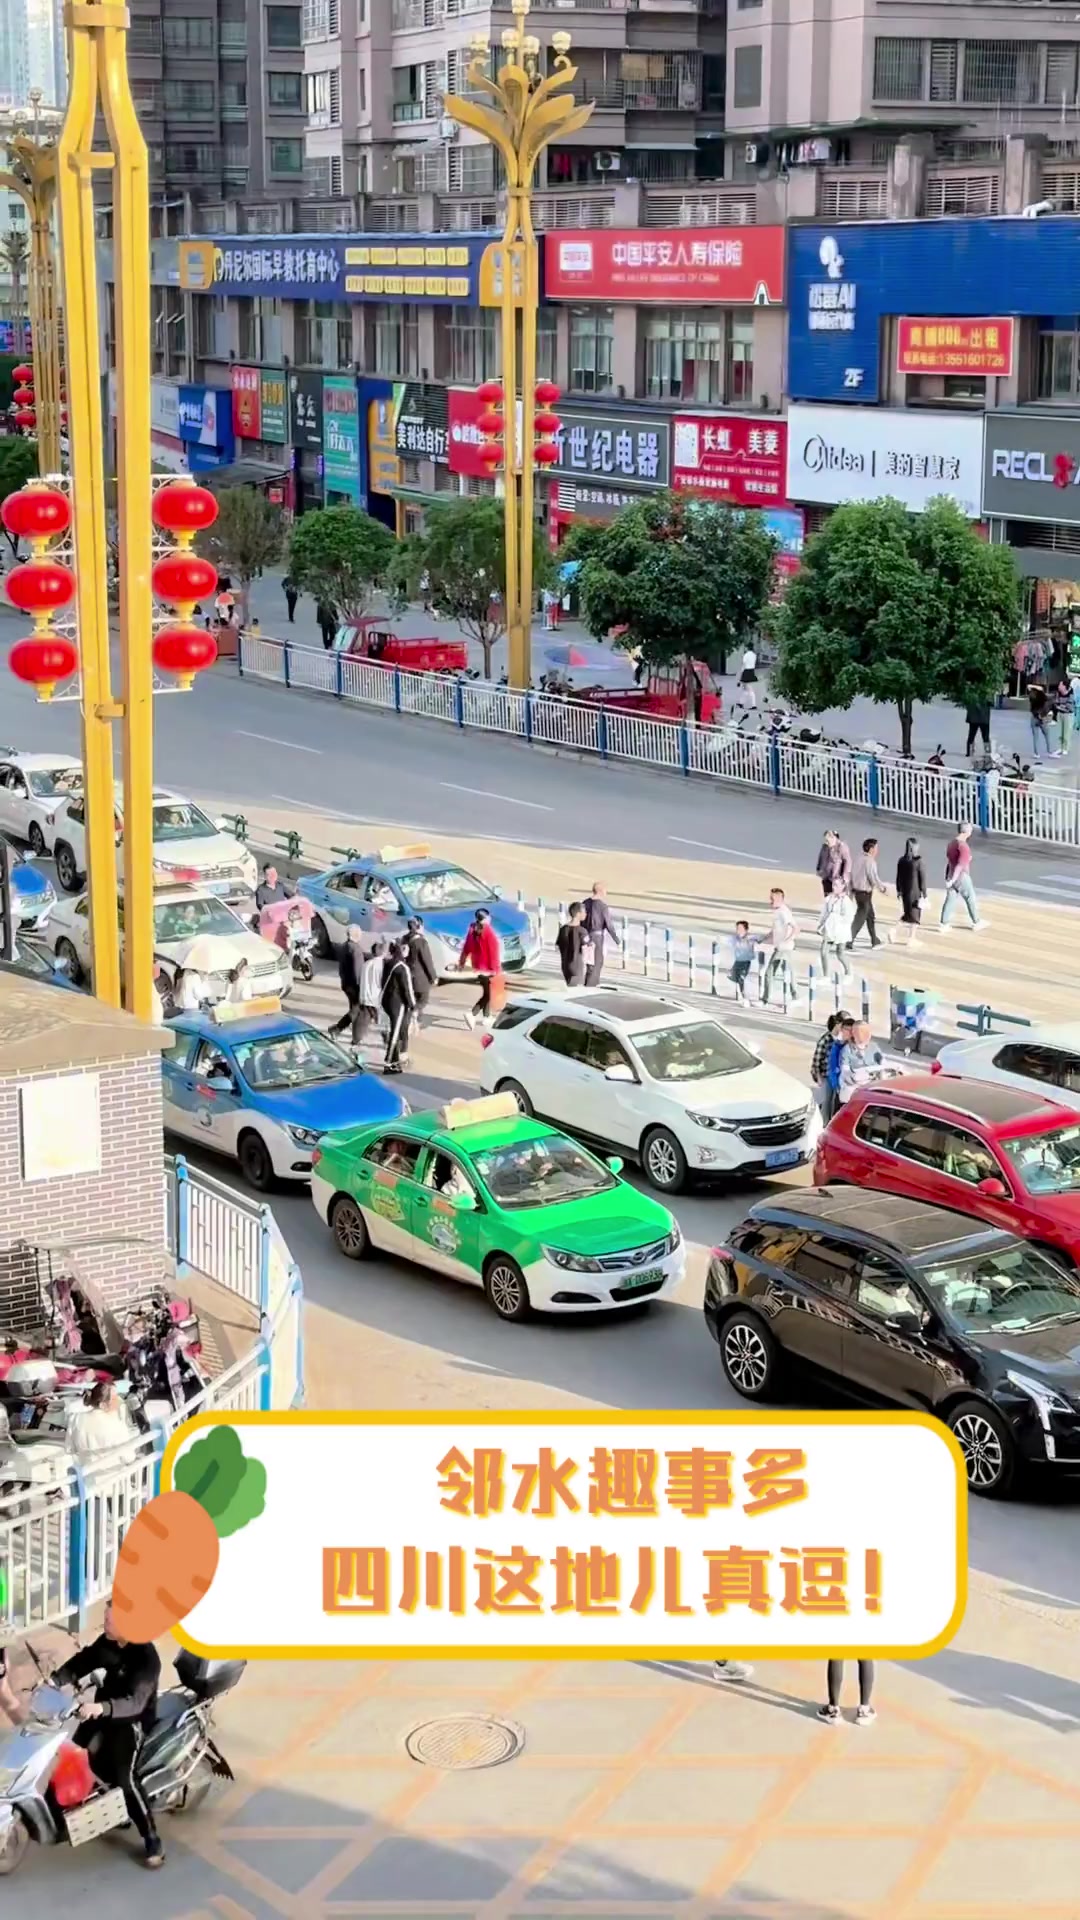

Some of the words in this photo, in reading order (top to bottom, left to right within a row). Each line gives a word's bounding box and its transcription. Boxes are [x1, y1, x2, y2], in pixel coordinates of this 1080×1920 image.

[611, 241, 743, 267] 中国平安人寿保险
[702, 424, 732, 451] 长虹
[803, 434, 863, 473] Midea
[886, 451, 960, 480] 美的智慧家
